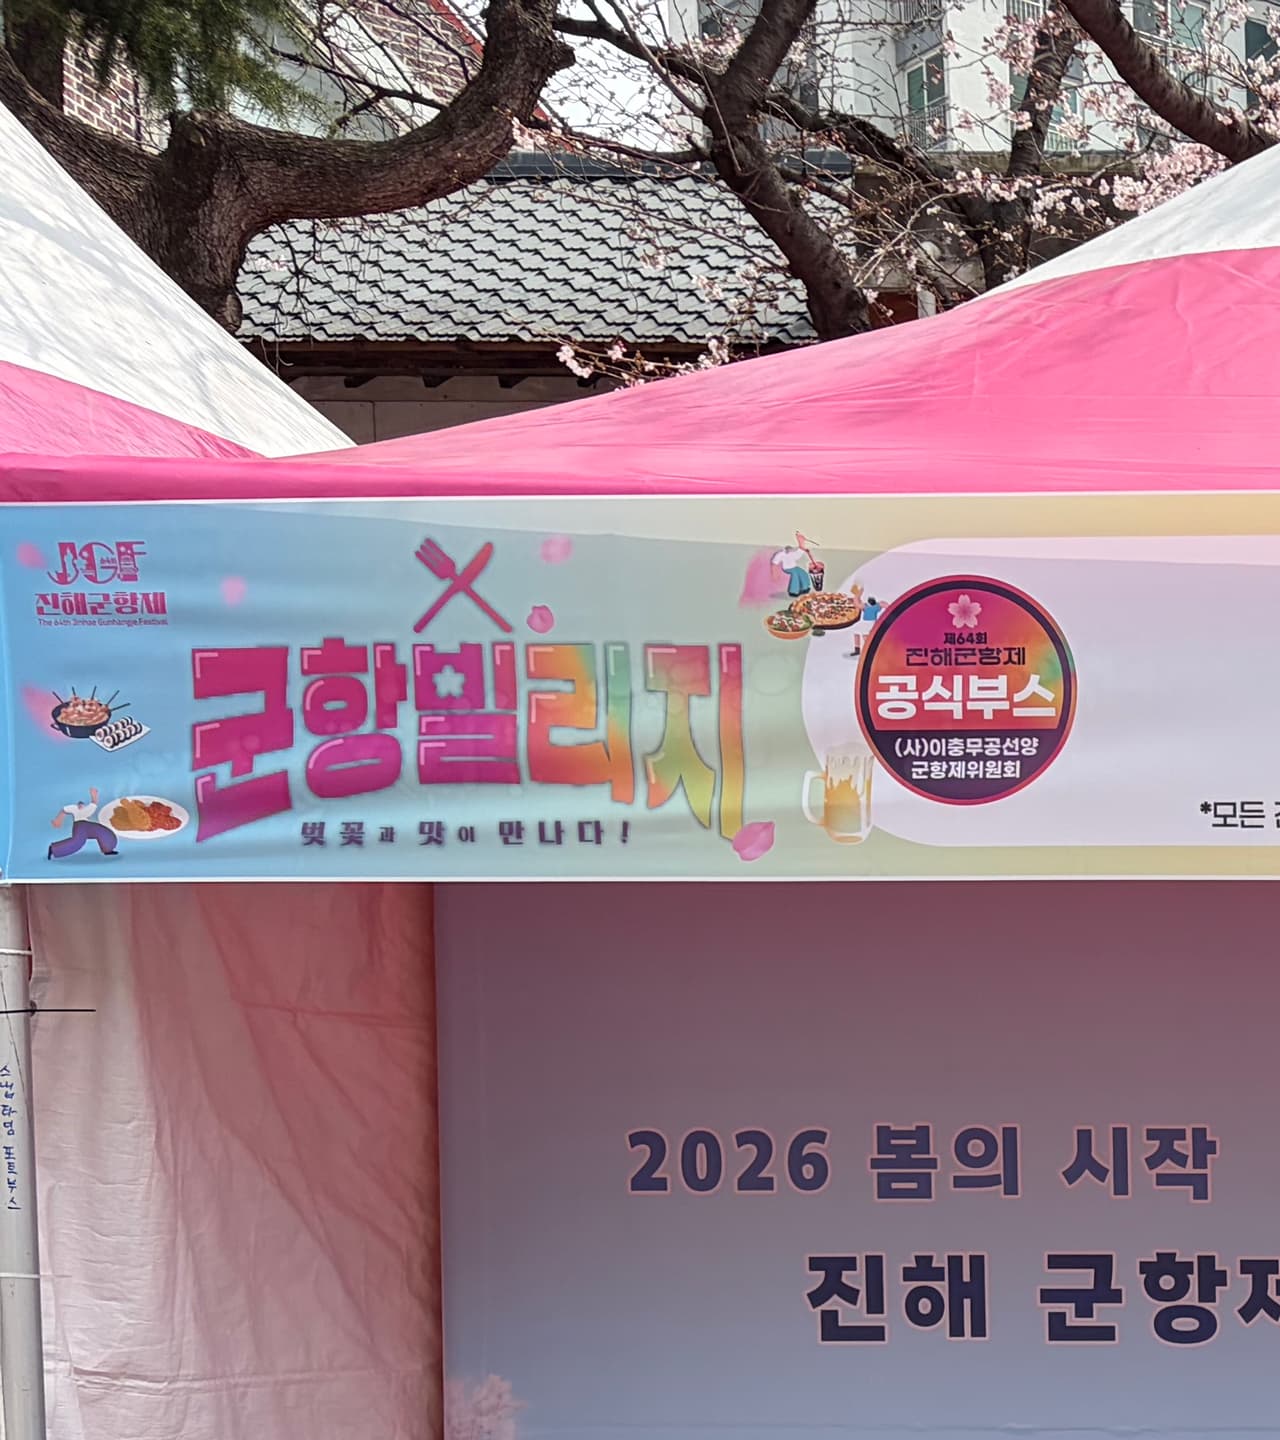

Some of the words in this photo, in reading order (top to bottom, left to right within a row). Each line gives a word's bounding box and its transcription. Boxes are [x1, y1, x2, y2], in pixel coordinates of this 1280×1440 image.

[35, 591, 167, 616] 진해군항제
[944, 632, 987, 645] 제64회
[906, 647, 1026, 667] 진해군항제
[875, 674, 1056, 720] 공식부스
[191, 637, 745, 842] 군항빌리지
[895, 737, 1039, 757] (사)이충무공선양
[911, 760, 1021, 780] 군항제위원회
[301, 821, 396, 847] 벚꽃과
[418, 820, 476, 846] 맛이
[499, 820, 630, 846] 만나다!
[628, 1130, 830, 1193] 2026
[868, 1124, 1020, 1199] 봄의
[1061, 1126, 1218, 1200] 시작
[806, 1252, 988, 1343] 진해
